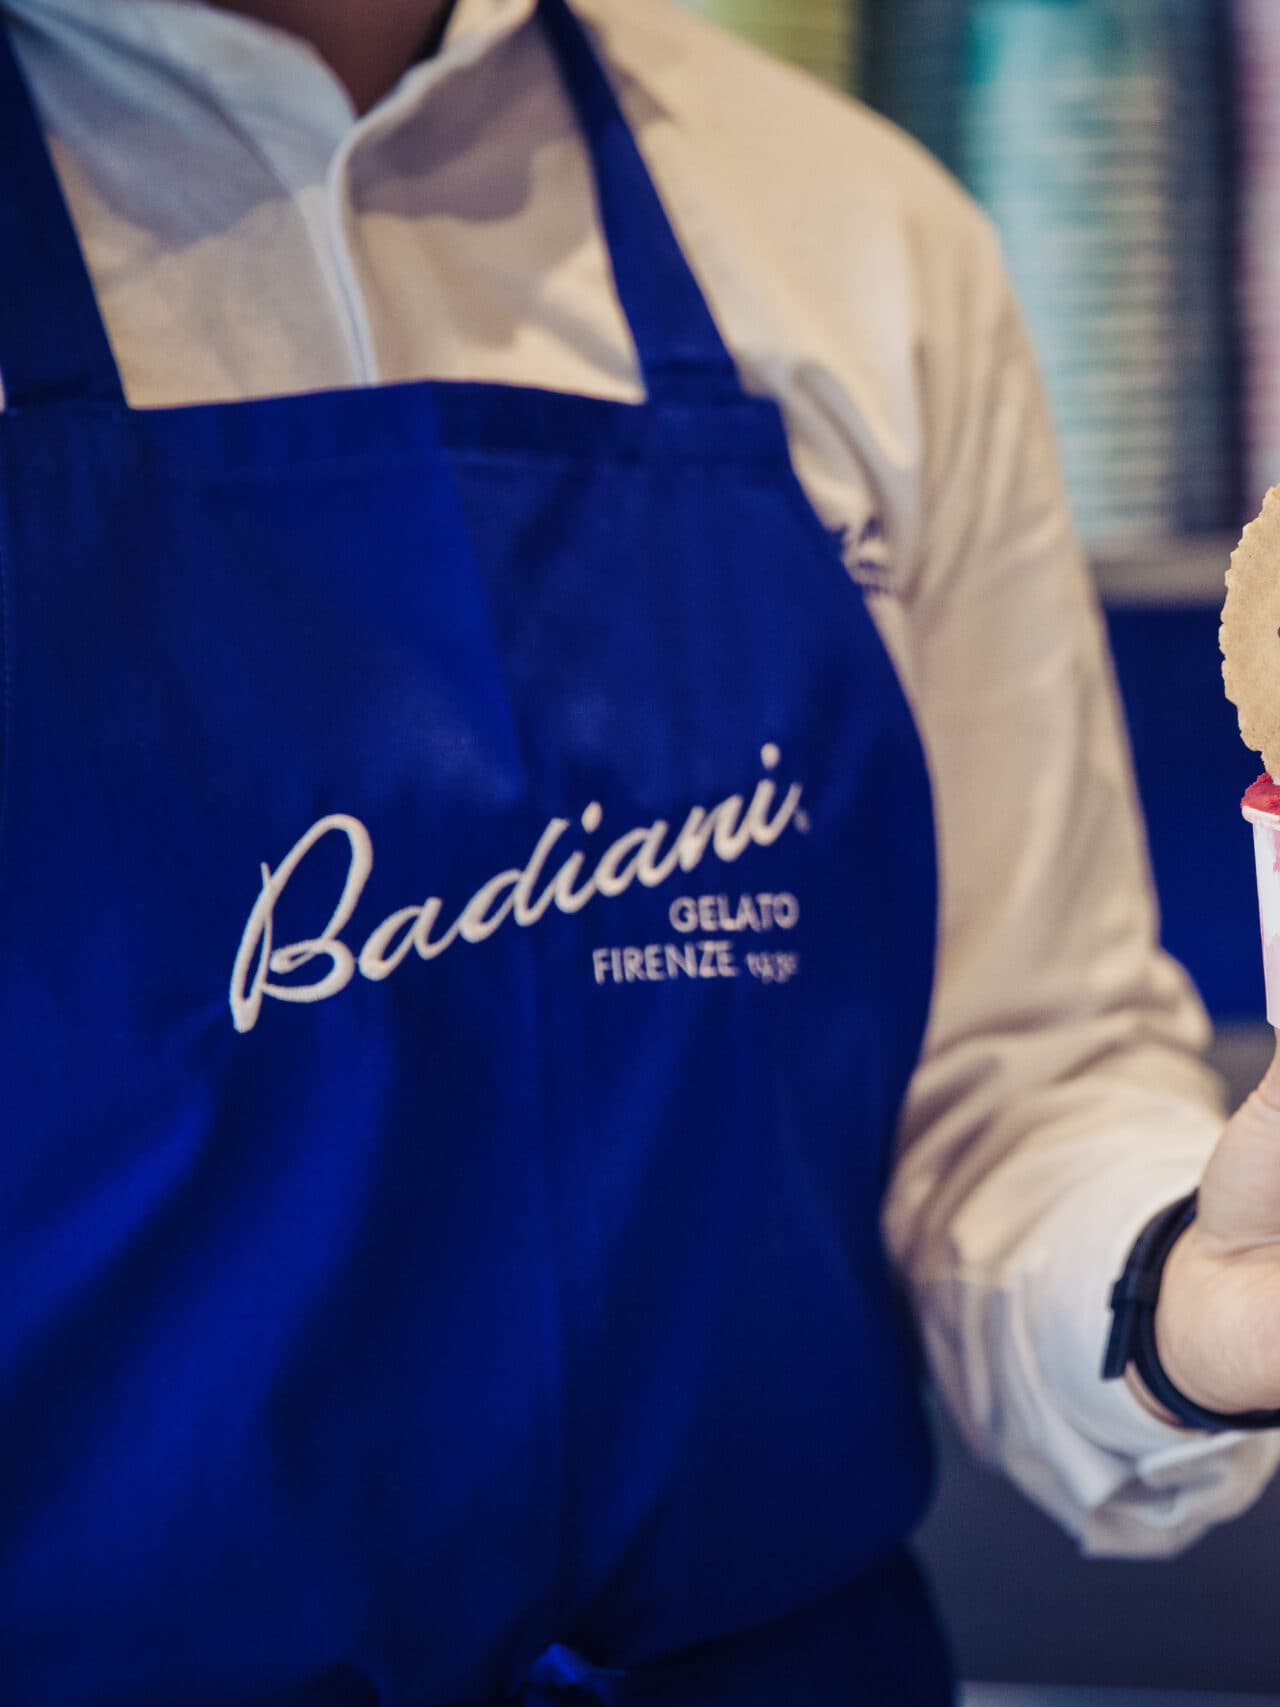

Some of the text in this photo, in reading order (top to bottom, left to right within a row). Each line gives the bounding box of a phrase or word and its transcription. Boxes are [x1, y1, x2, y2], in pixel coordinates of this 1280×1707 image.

[229, 742, 802, 1033] Badiani
[669, 892, 799, 933] GELATO
[592, 941, 738, 985] FIRENZE
